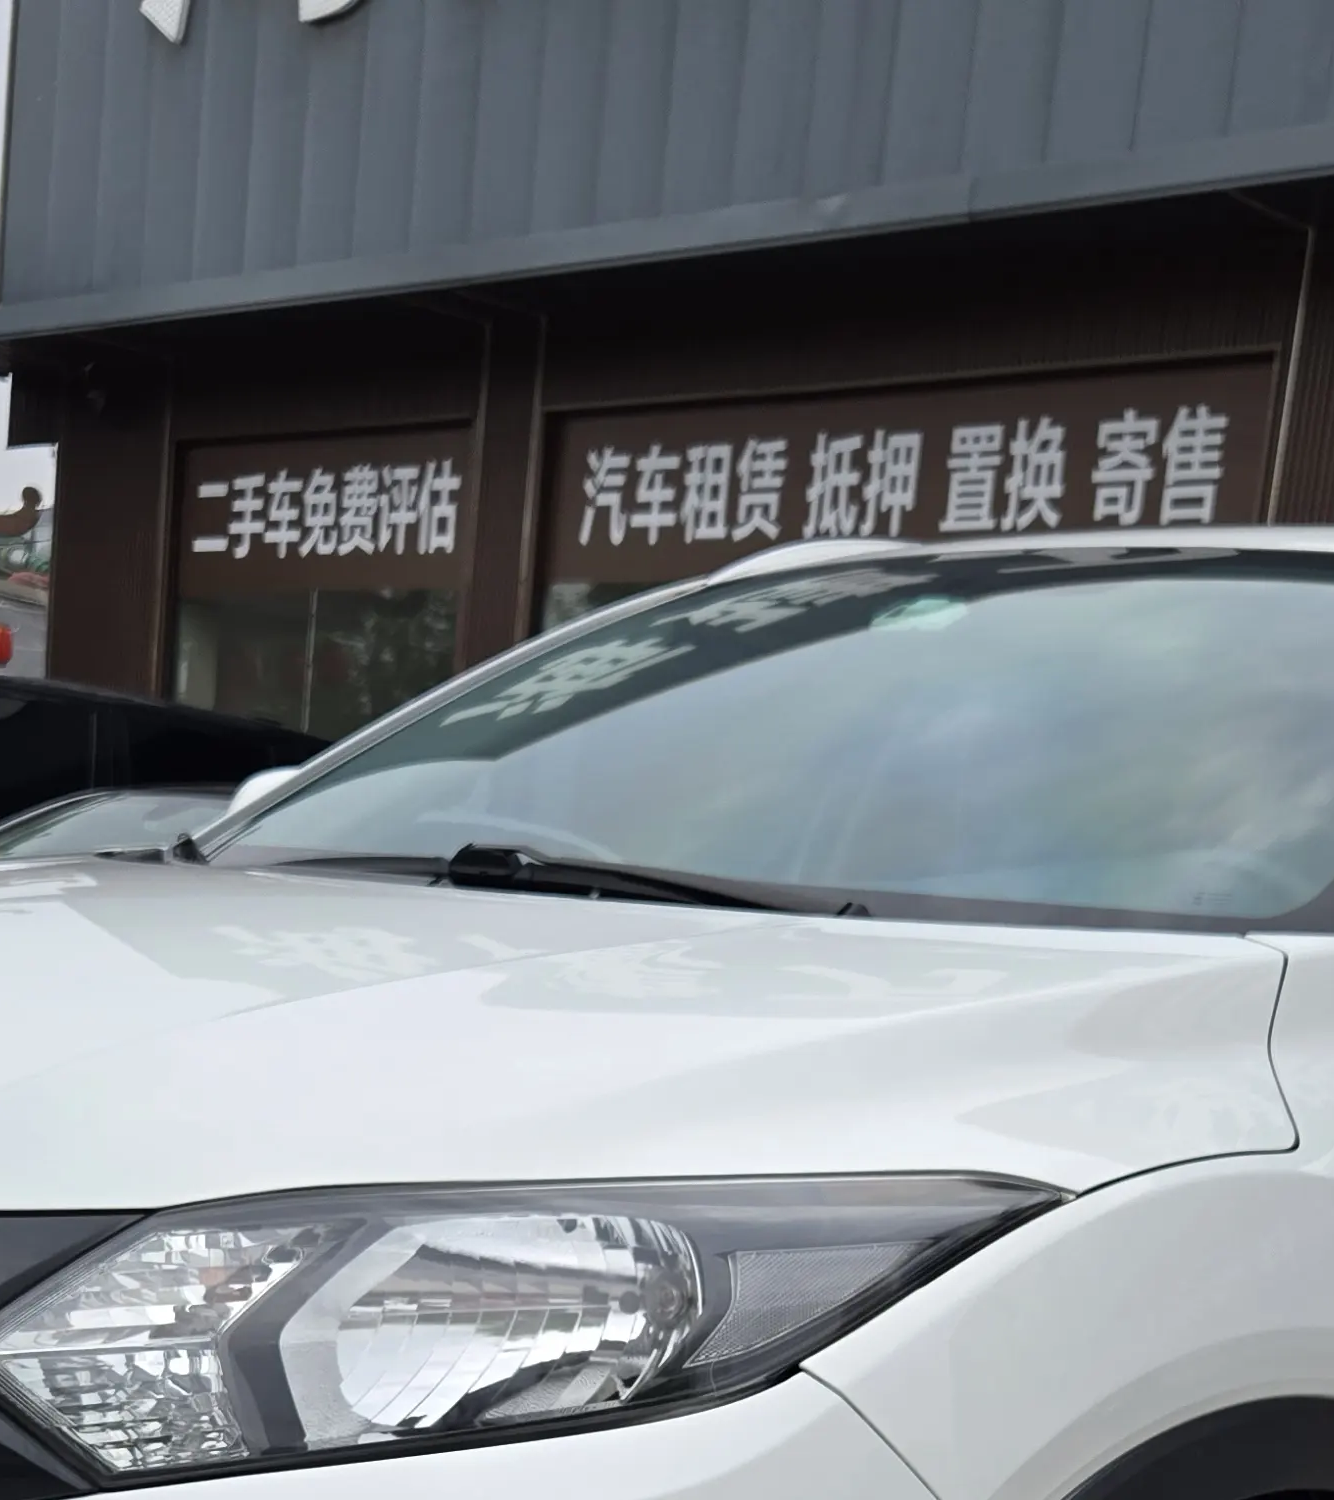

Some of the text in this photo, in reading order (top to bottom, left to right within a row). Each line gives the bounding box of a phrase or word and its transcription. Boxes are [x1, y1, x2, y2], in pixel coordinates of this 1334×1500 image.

[192, 458, 462, 559] 二手车免费评估
[578, 404, 1229, 547] 汽车租赁 抵押 置换 寄售
